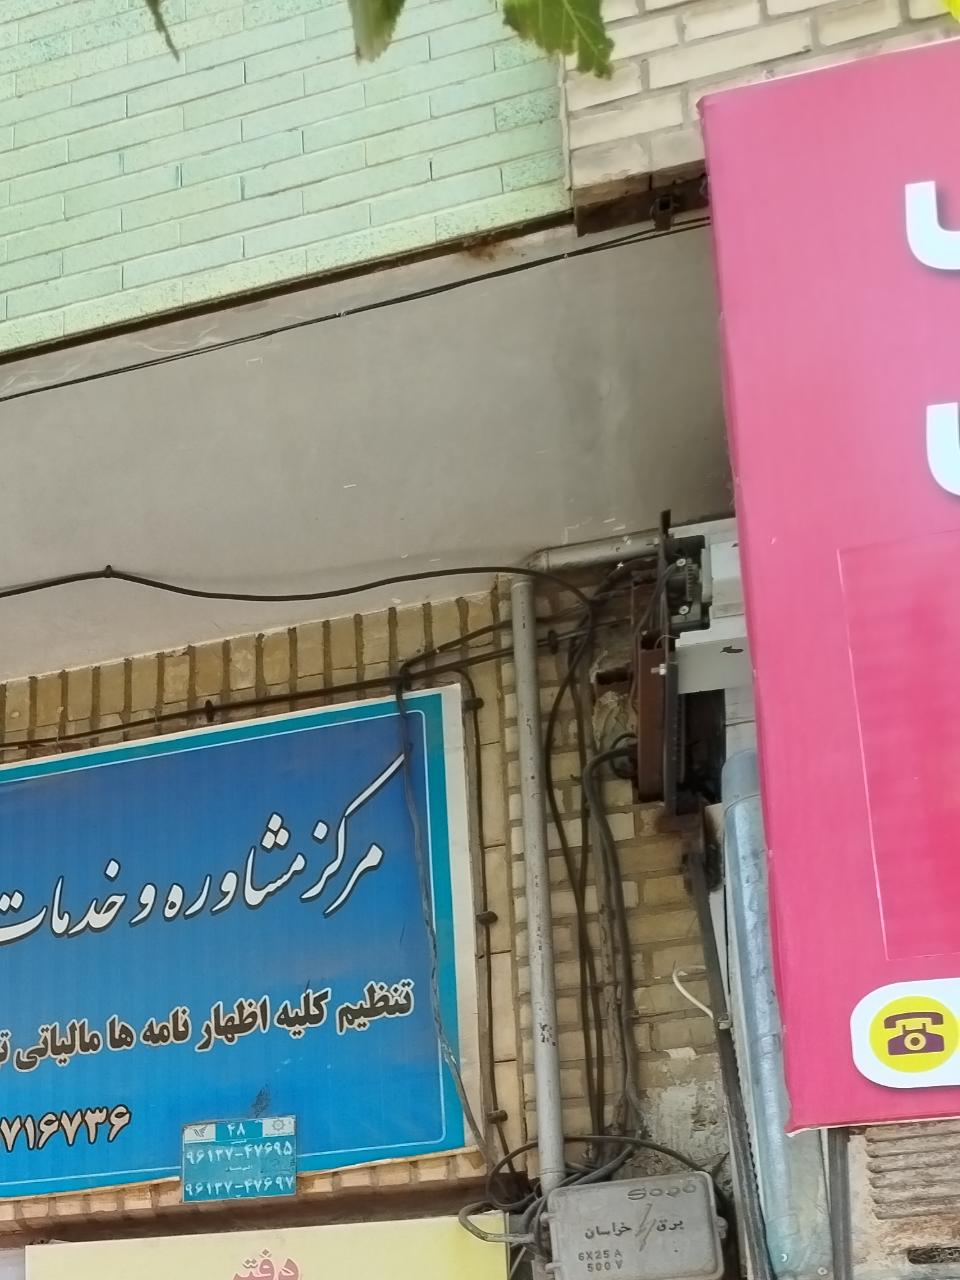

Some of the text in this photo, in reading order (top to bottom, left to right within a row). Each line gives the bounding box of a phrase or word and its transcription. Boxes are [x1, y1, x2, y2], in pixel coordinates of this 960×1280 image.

[300, 752, 406, 918] مرکز
[162, 812, 307, 921] مشاوره
[129, 882, 157, 927] و
[106, 1013, 136, 1051] ها
[141, 1005, 192, 1048] نامه
[195, 994, 270, 1052] اظهار
[274, 986, 333, 1038] کلیه
[335, 978, 416, 1034] تنظیم
[13, 1017, 103, 1072] مالیاتی
[226, 1122, 246, 1137] ۴۸
[584, 1221, 633, 1240] خراسان
